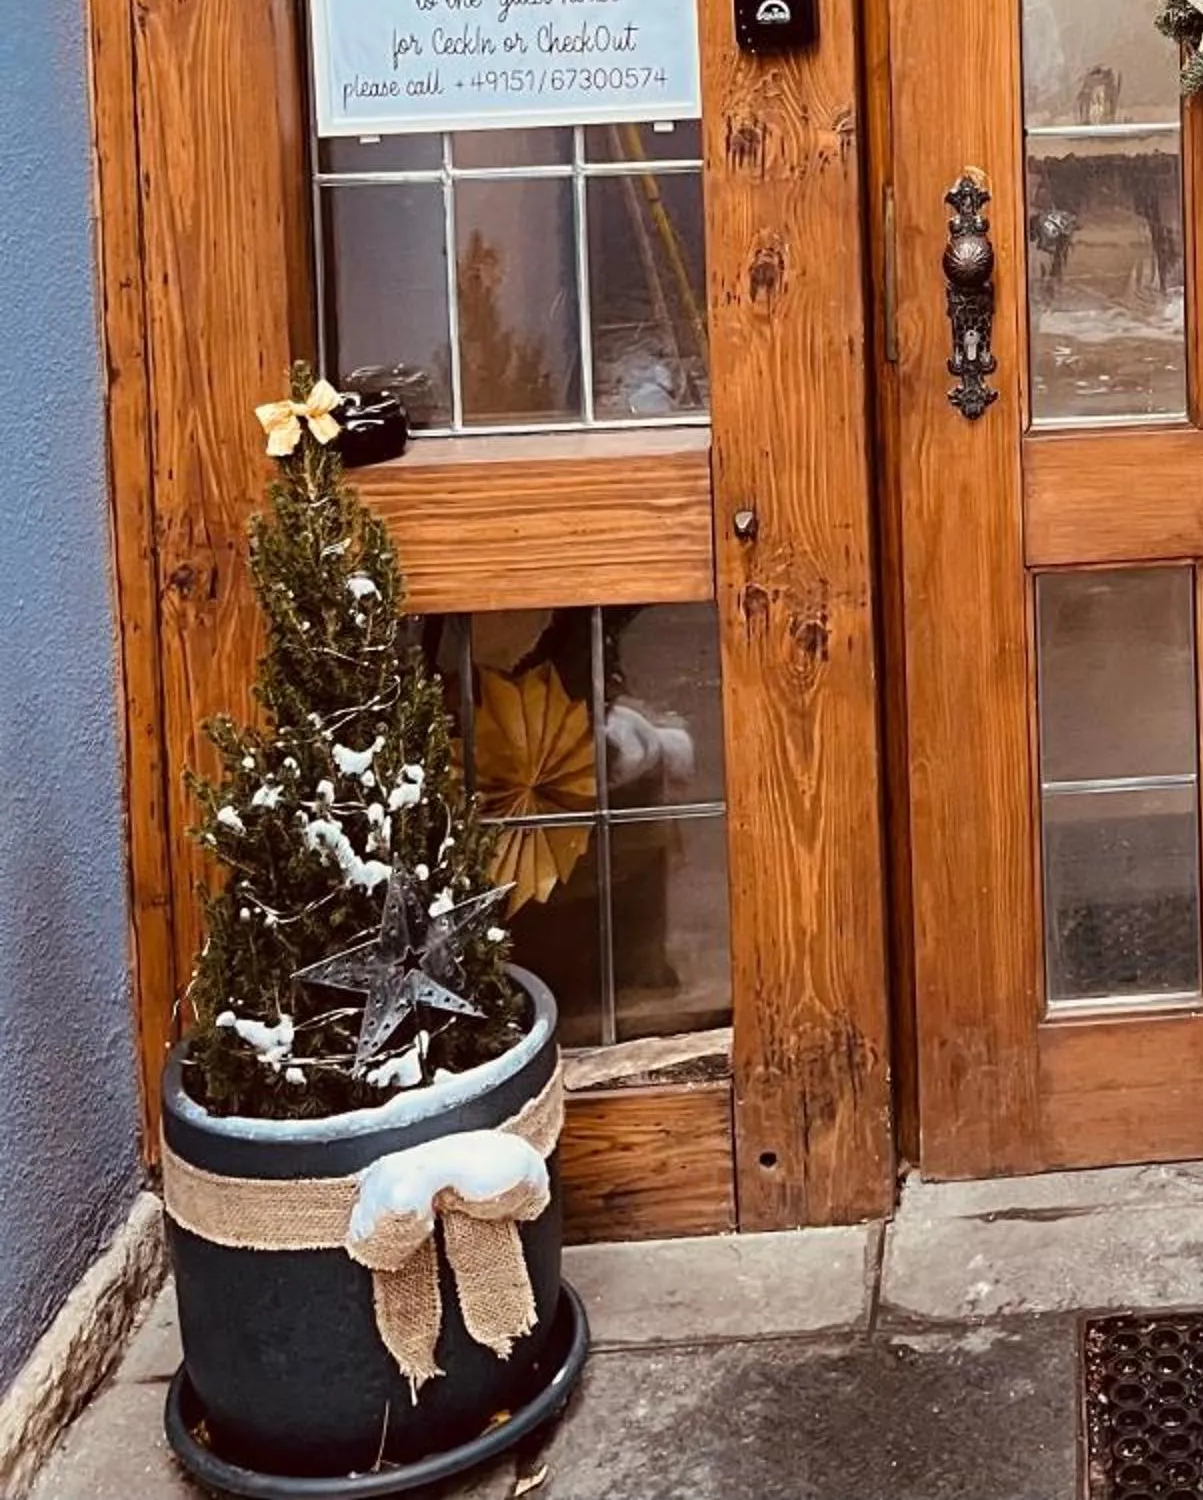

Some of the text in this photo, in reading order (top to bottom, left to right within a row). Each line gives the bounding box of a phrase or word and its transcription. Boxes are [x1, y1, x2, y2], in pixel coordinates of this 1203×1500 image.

[393, 29, 422, 69] for
[504, 30, 528, 53] or
[537, 22, 638, 54] CheckOut
[343, 74, 399, 109] please
[407, 71, 444, 96] call
